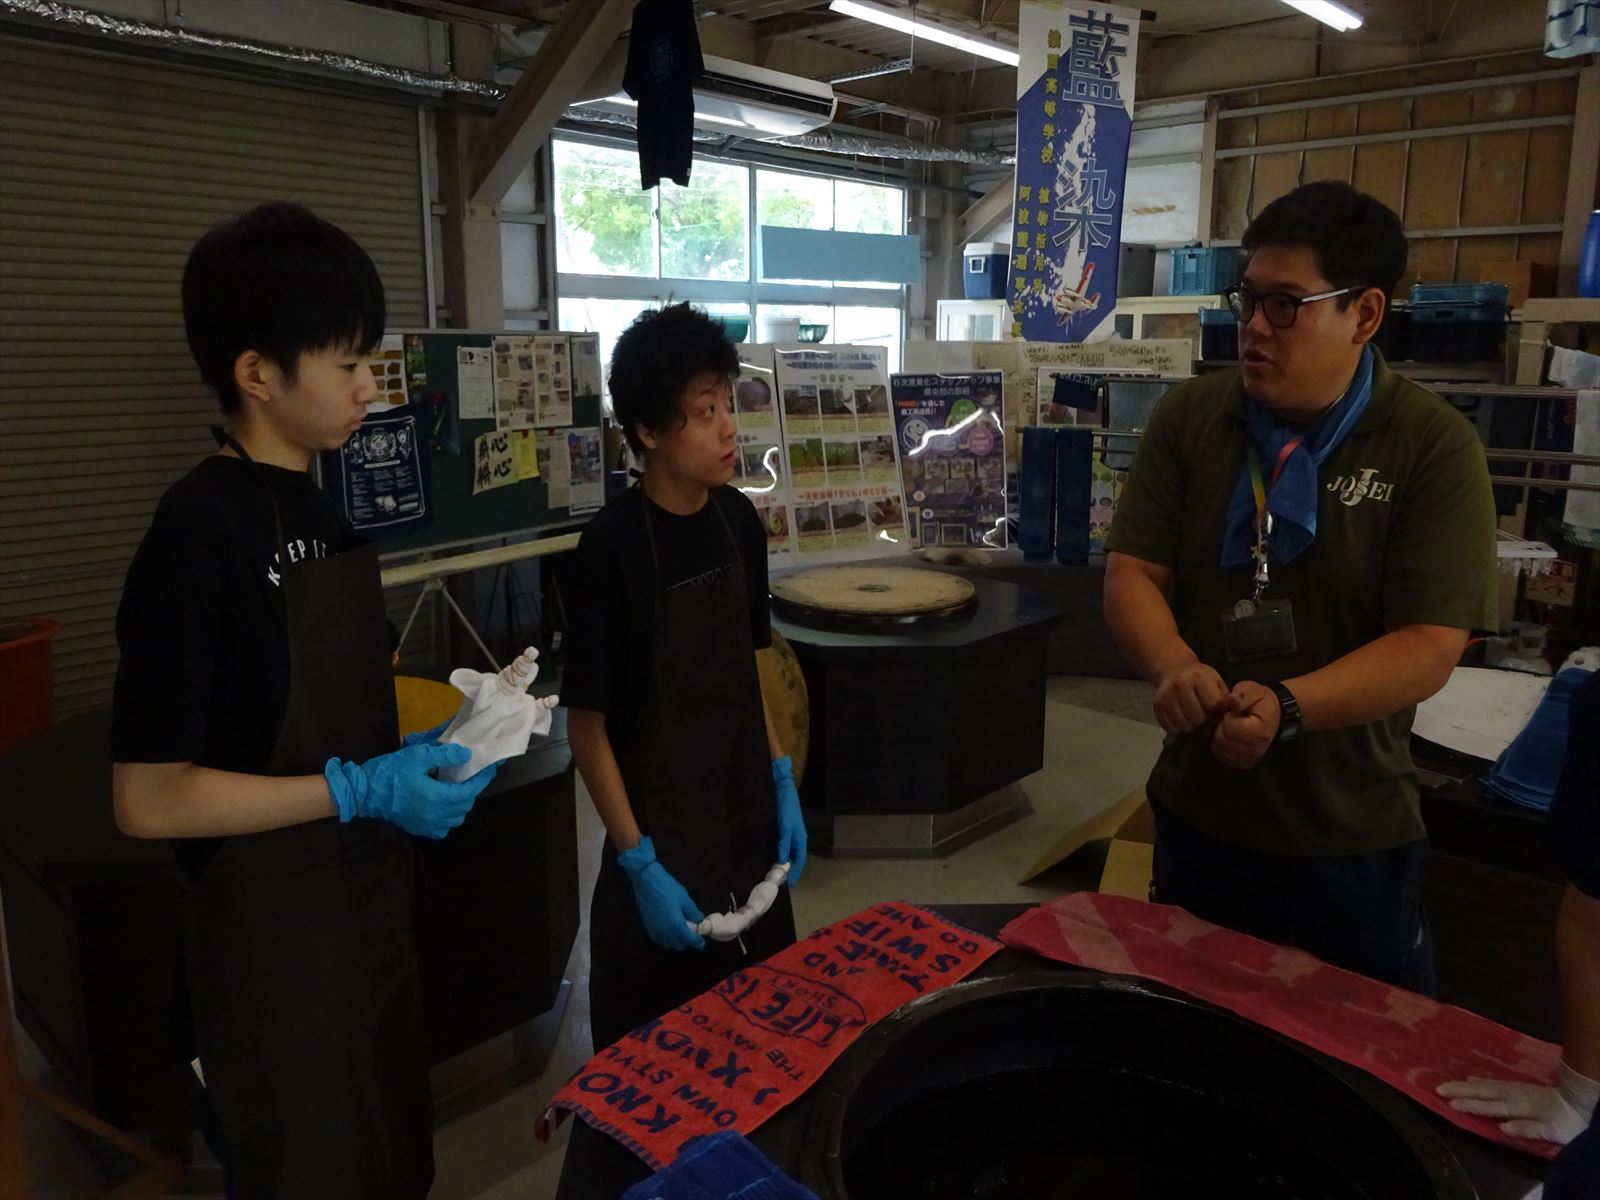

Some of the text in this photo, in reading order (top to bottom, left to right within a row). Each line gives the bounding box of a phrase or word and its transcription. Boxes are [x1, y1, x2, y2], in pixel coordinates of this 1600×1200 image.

[1051, 9, 1129, 251] 藍染
[1326, 474, 1397, 503] JOSEI
[940, 931, 980, 955] GO
[804, 953, 866, 977] AND
[769, 976, 839, 1008] SHORT
[719, 971, 843, 1047] LIFE IS
[766, 1049, 805, 1081] THE
[574, 1065, 682, 1133] KNO
[672, 1084, 737, 1127] OWN
